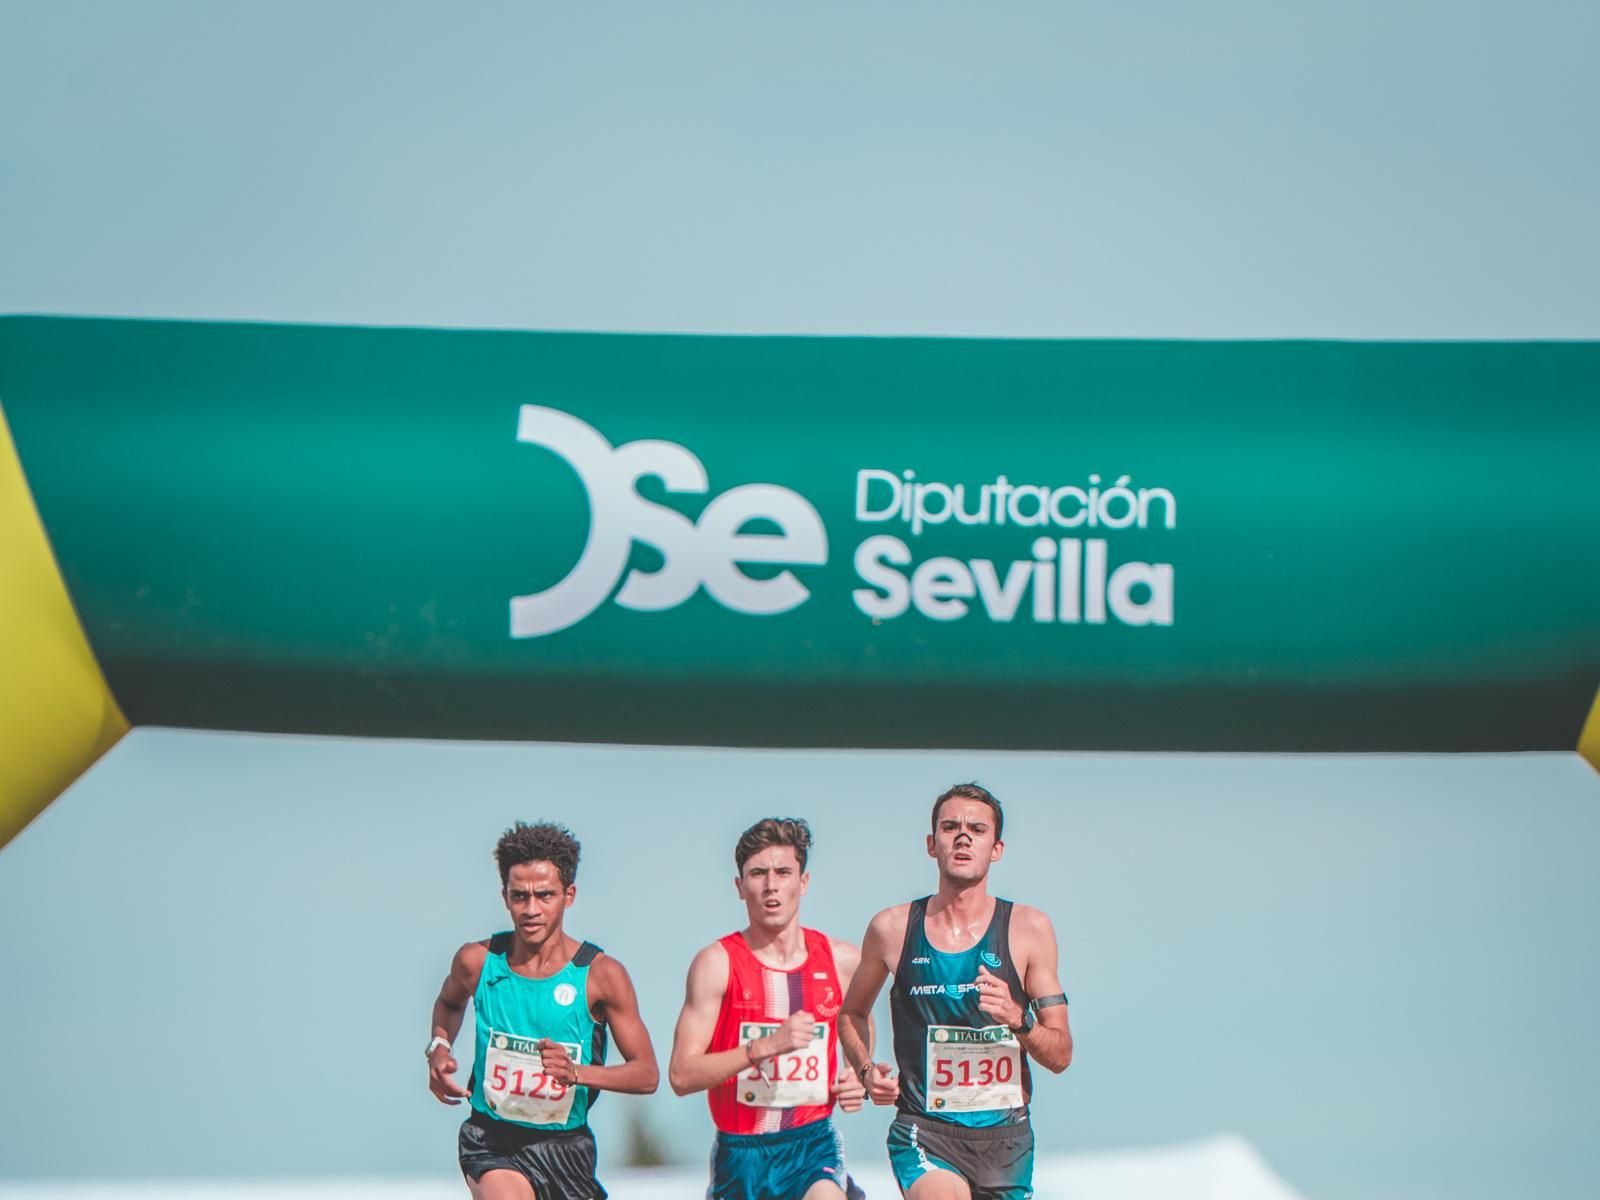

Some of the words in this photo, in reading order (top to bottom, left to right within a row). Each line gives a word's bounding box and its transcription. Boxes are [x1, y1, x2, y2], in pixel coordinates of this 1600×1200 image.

[856, 469, 1176, 534] Diputación
[853, 535, 1173, 624] Sevilla
[512, 1039, 540, 1053] ITÁL
[954, 1031, 997, 1042] ITÁLICA
[491, 1063, 567, 1101] 5129
[935, 1055, 1013, 1087] 5130
